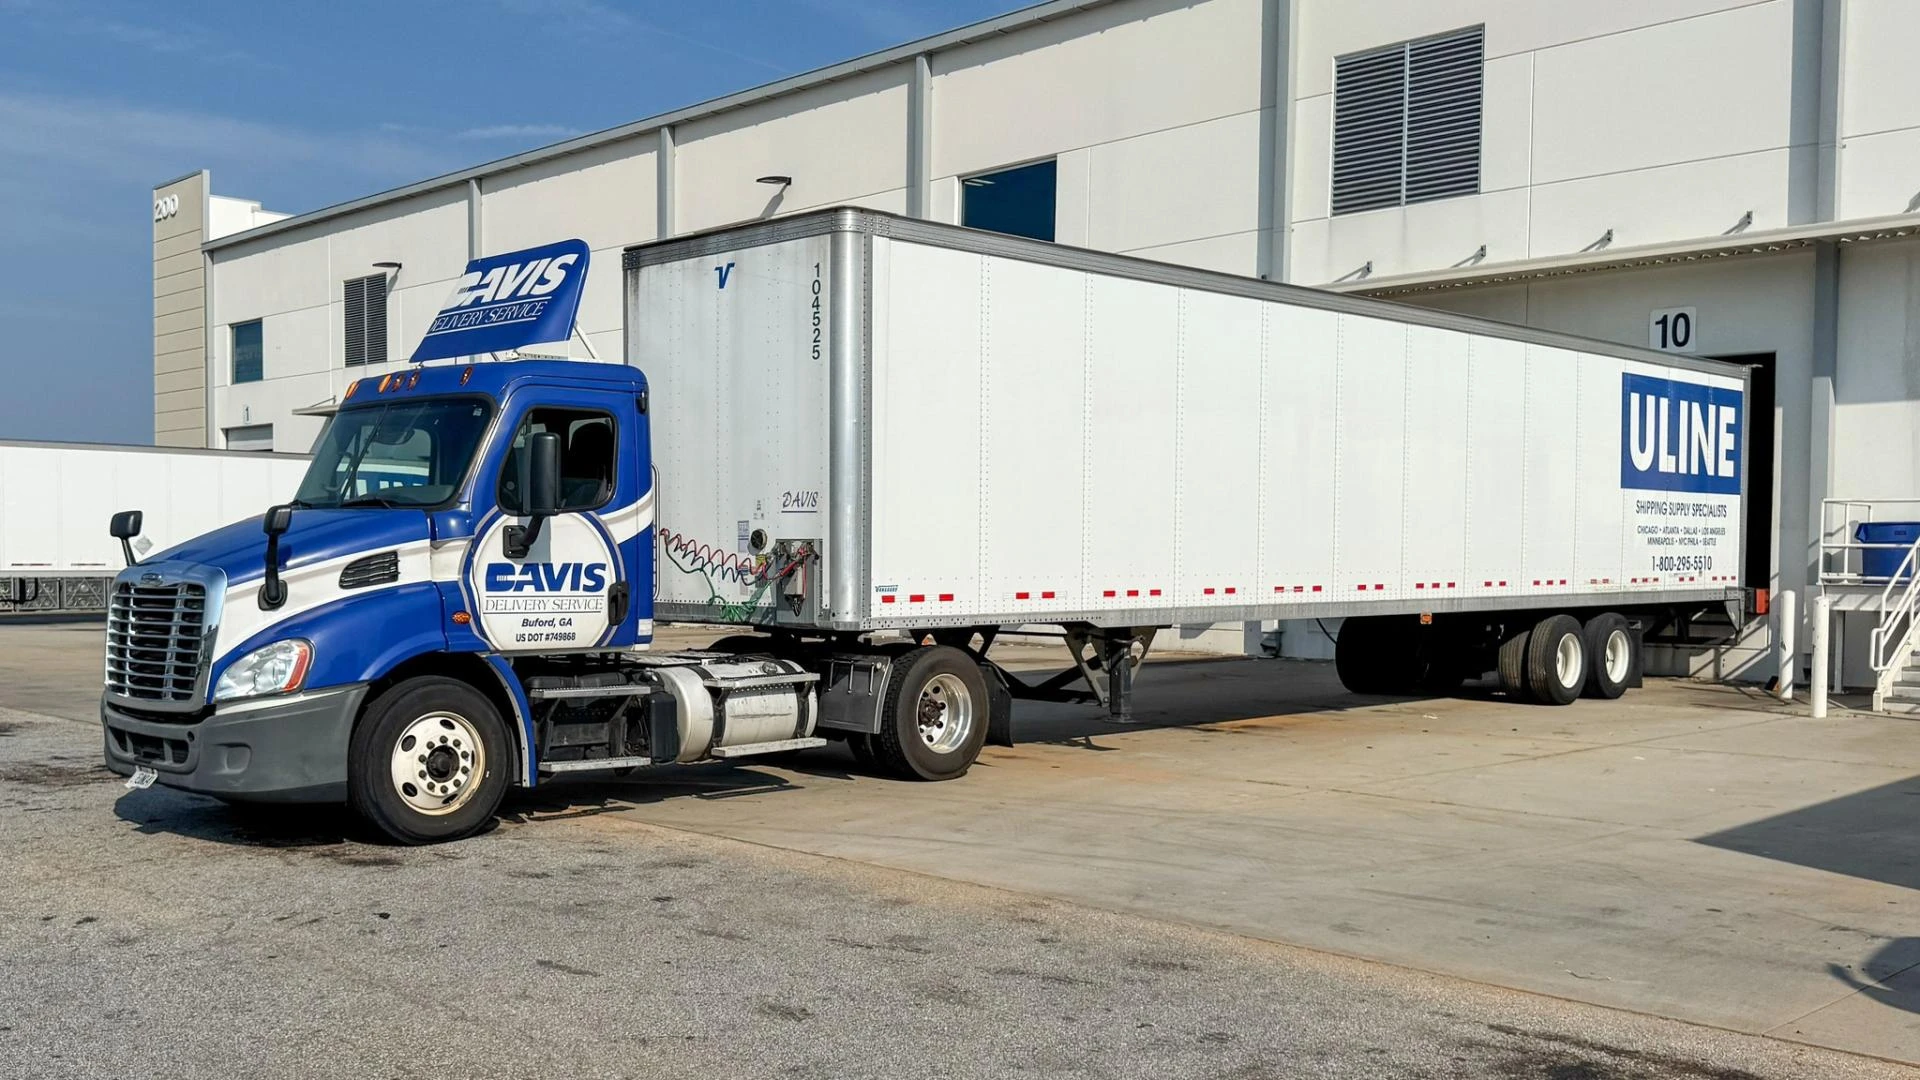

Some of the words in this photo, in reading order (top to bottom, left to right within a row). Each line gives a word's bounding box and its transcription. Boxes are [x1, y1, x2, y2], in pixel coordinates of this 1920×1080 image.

[154, 194, 178, 222] 200
[441, 253, 579, 311] DAVIS
[485, 301, 548, 323] SERVICE
[1655, 312, 1691, 349] 10
[1629, 392, 1736, 477] ULINE
[782, 491, 818, 508] DAVIS
[1635, 500, 1667, 515] SHIPPING
[1668, 503, 1691, 516] SUPPLY
[1692, 503, 1727, 517] SPECIALISTS
[1637, 526, 1658, 535] CHICAGO
[1663, 527, 1679, 535] ATLANTA
[1652, 556, 1712, 571] 1-800-295-5510
[485, 563, 606, 592] DAVIS
[485, 600, 548, 611] DELIVERY
[551, 599, 603, 611] SERVICE
[521, 618, 556, 628] Buford,
[559, 618, 573, 627] GA
[515, 633, 526, 642] US
[527, 633, 543, 642] DOT
[545, 632, 576, 641] #749868
